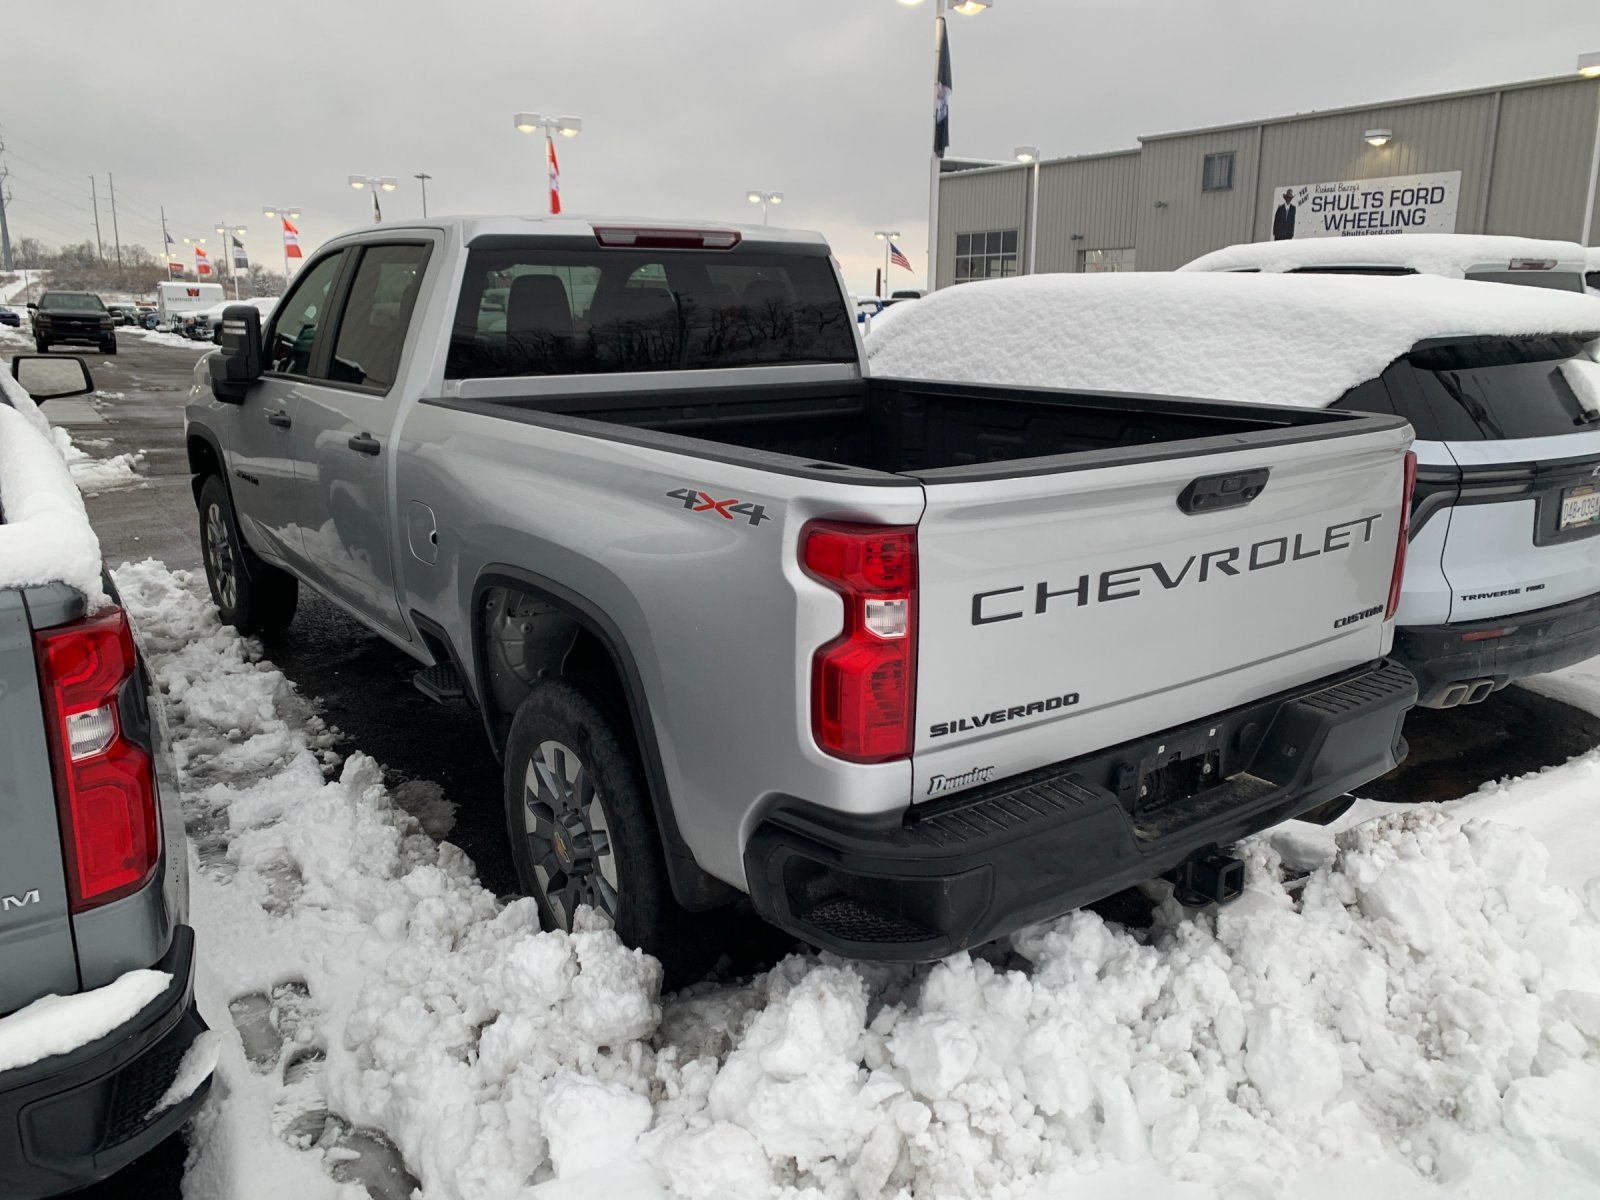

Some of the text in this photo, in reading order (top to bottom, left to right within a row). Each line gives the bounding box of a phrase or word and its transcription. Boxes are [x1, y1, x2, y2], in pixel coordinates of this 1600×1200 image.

[1311, 190, 1383, 213] SHULTS
[1389, 186, 1446, 207] FORD
[1324, 208, 1427, 231] WHEELING
[971, 513, 1383, 626] CHEVROLET
[1461, 588, 1521, 601] TRAVERSE
[1333, 604, 1384, 629] CUSTOM
[929, 692, 1080, 738] SILVERADO
